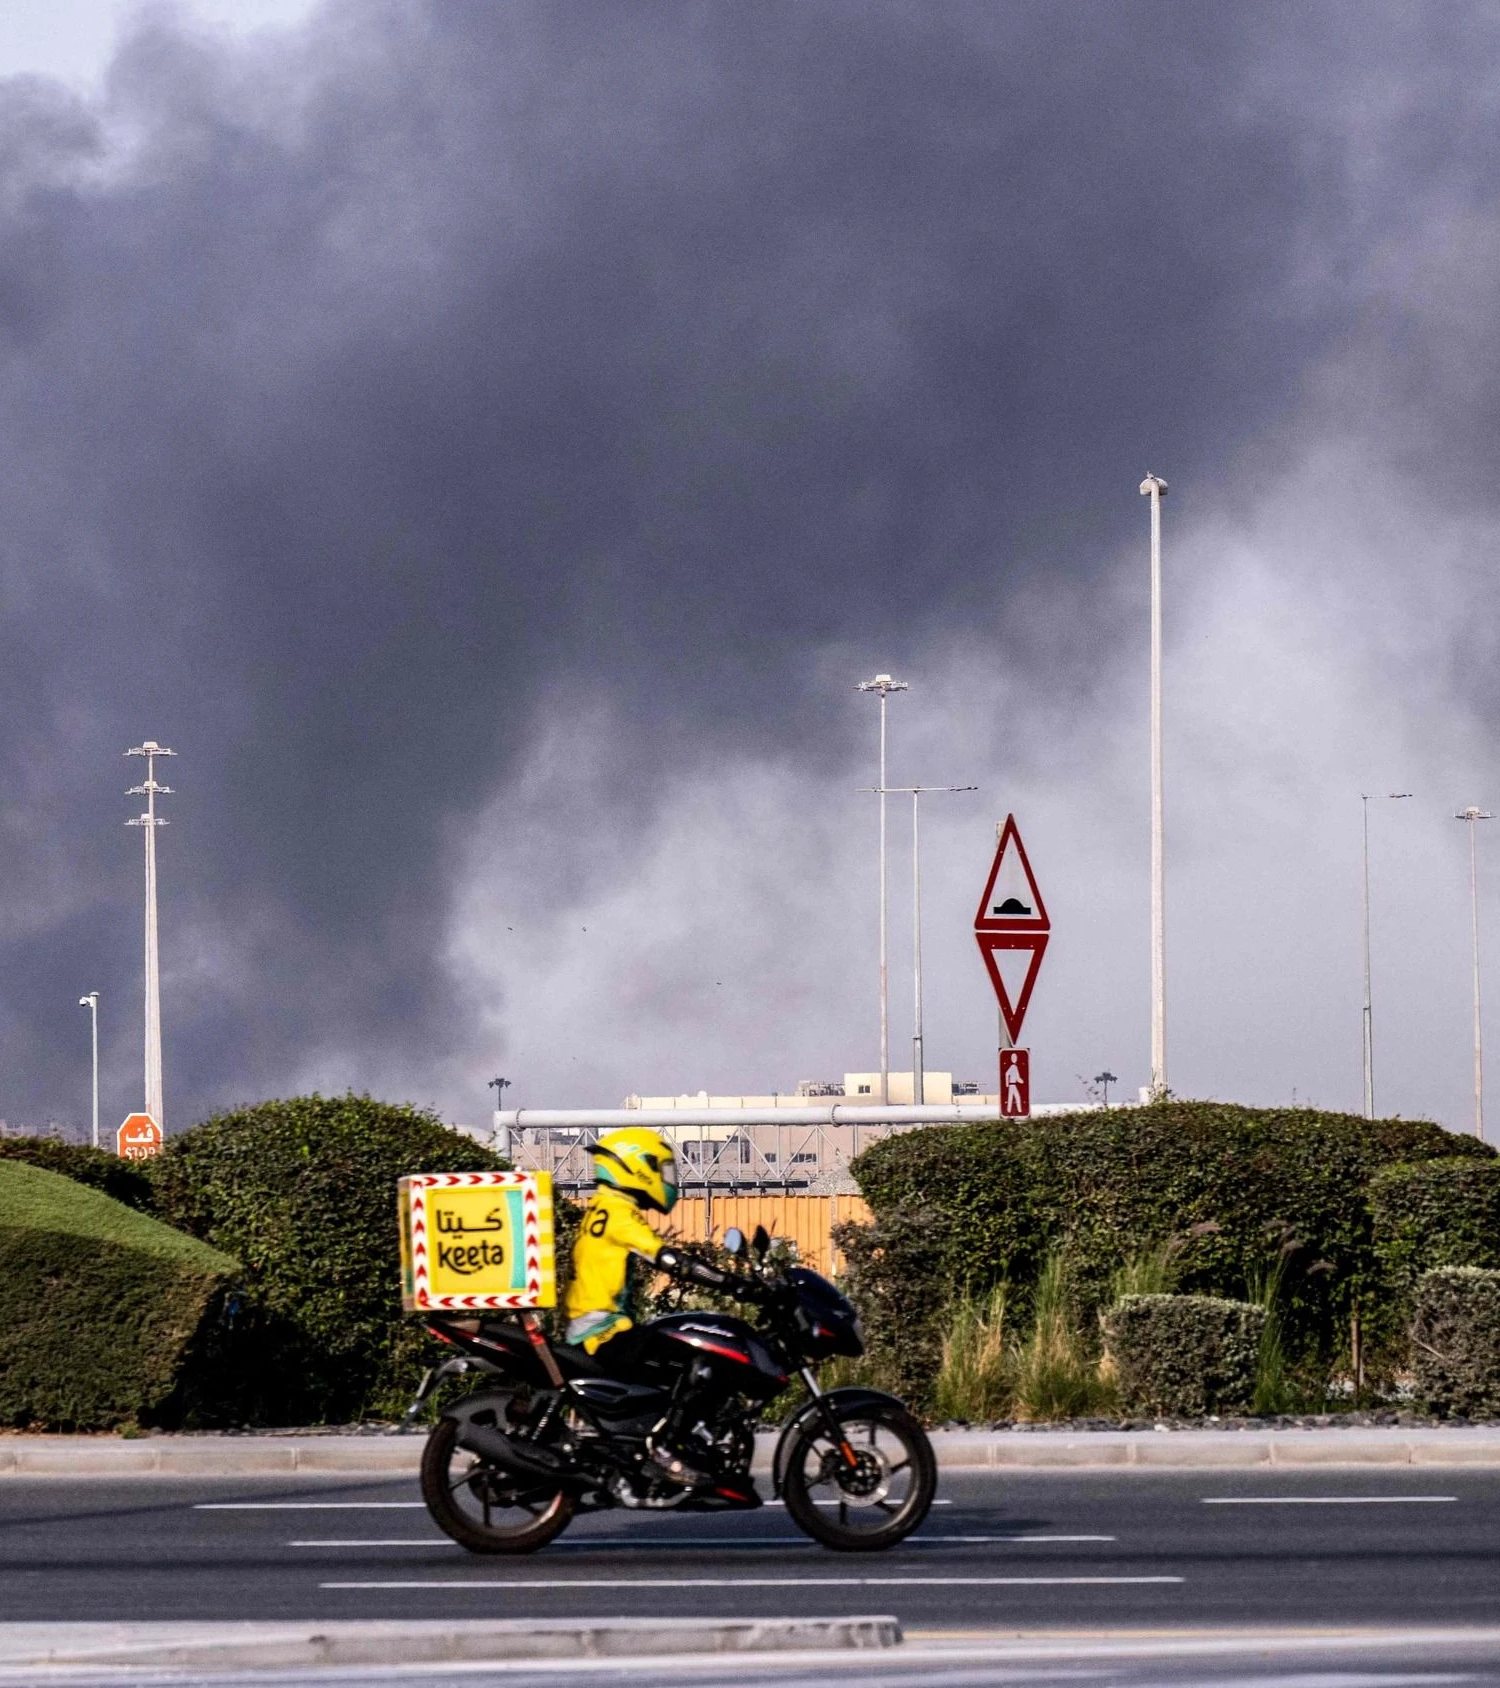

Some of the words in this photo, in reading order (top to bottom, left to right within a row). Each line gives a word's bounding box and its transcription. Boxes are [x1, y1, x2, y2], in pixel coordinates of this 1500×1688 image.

[126, 1124, 154, 1142] قف
[436, 1208, 503, 1239] كيتا
[436, 1240, 504, 1275] keeta
